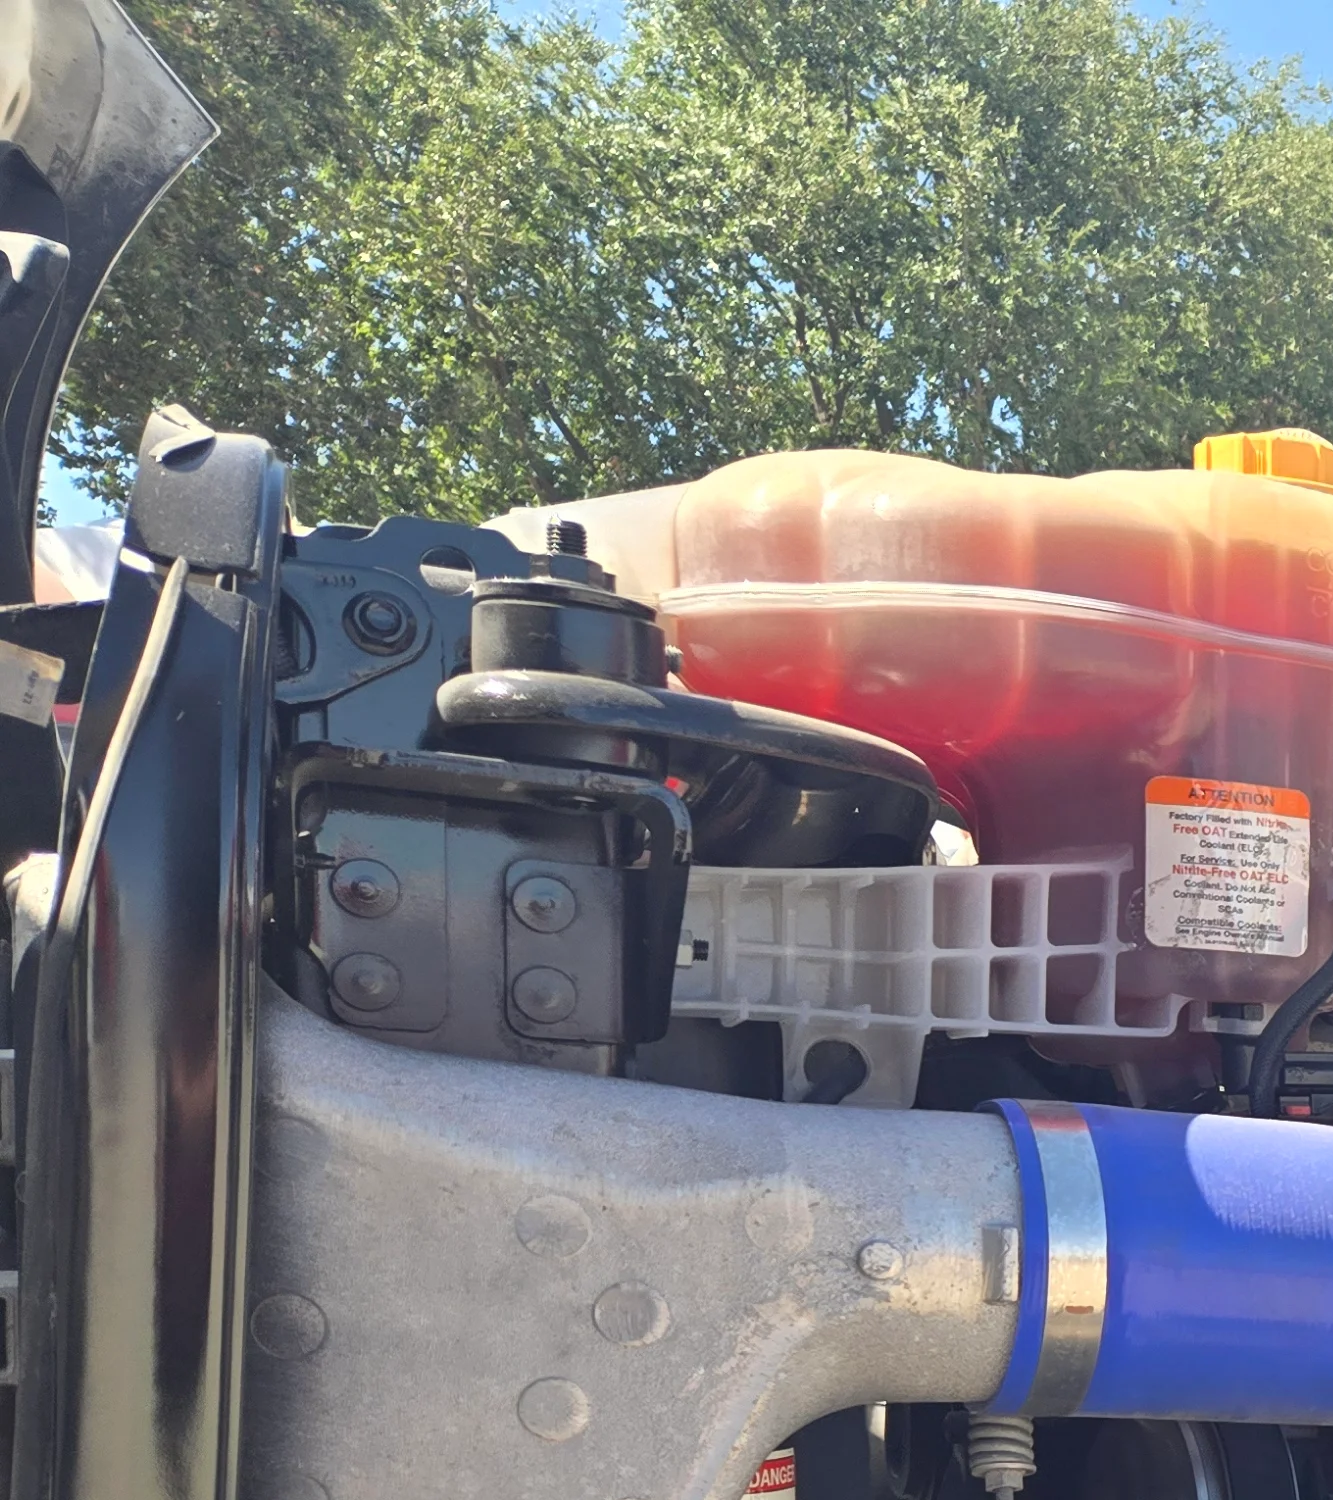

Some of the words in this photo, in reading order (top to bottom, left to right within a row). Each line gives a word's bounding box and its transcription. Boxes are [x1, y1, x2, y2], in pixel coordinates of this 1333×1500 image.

[1188, 787, 1275, 807] ATTENTION
[1169, 812, 1203, 823] Factory
[1206, 814, 1231, 825] Filled
[1233, 817, 1252, 826] with
[1173, 823, 1199, 835] Free
[1202, 825, 1227, 838] OAT
[1229, 831, 1270, 843] Extended
[1199, 839, 1235, 851] Coolant
[1180, 853, 1196, 863] For
[1241, 859, 1258, 868] Use
[1260, 861, 1280, 871] Only
[1172, 864, 1236, 879] Nitrite-Free
[1240, 871, 1265, 882] OAT
[1268, 873, 1289, 884] ELC
[1225, 883, 1239, 892] Do
[1240, 885, 1256, 893] Not
[1173, 890, 1234, 903] Conventional
[1235, 894, 1275, 907] Coolants
[1218, 905, 1244, 915] SCAs
[1175, 926, 1190, 935] See
[1192, 928, 1221, 938] Engine
[1177, 916, 1235, 928] Compatible
[1237, 920, 1283, 932] Coolants:
